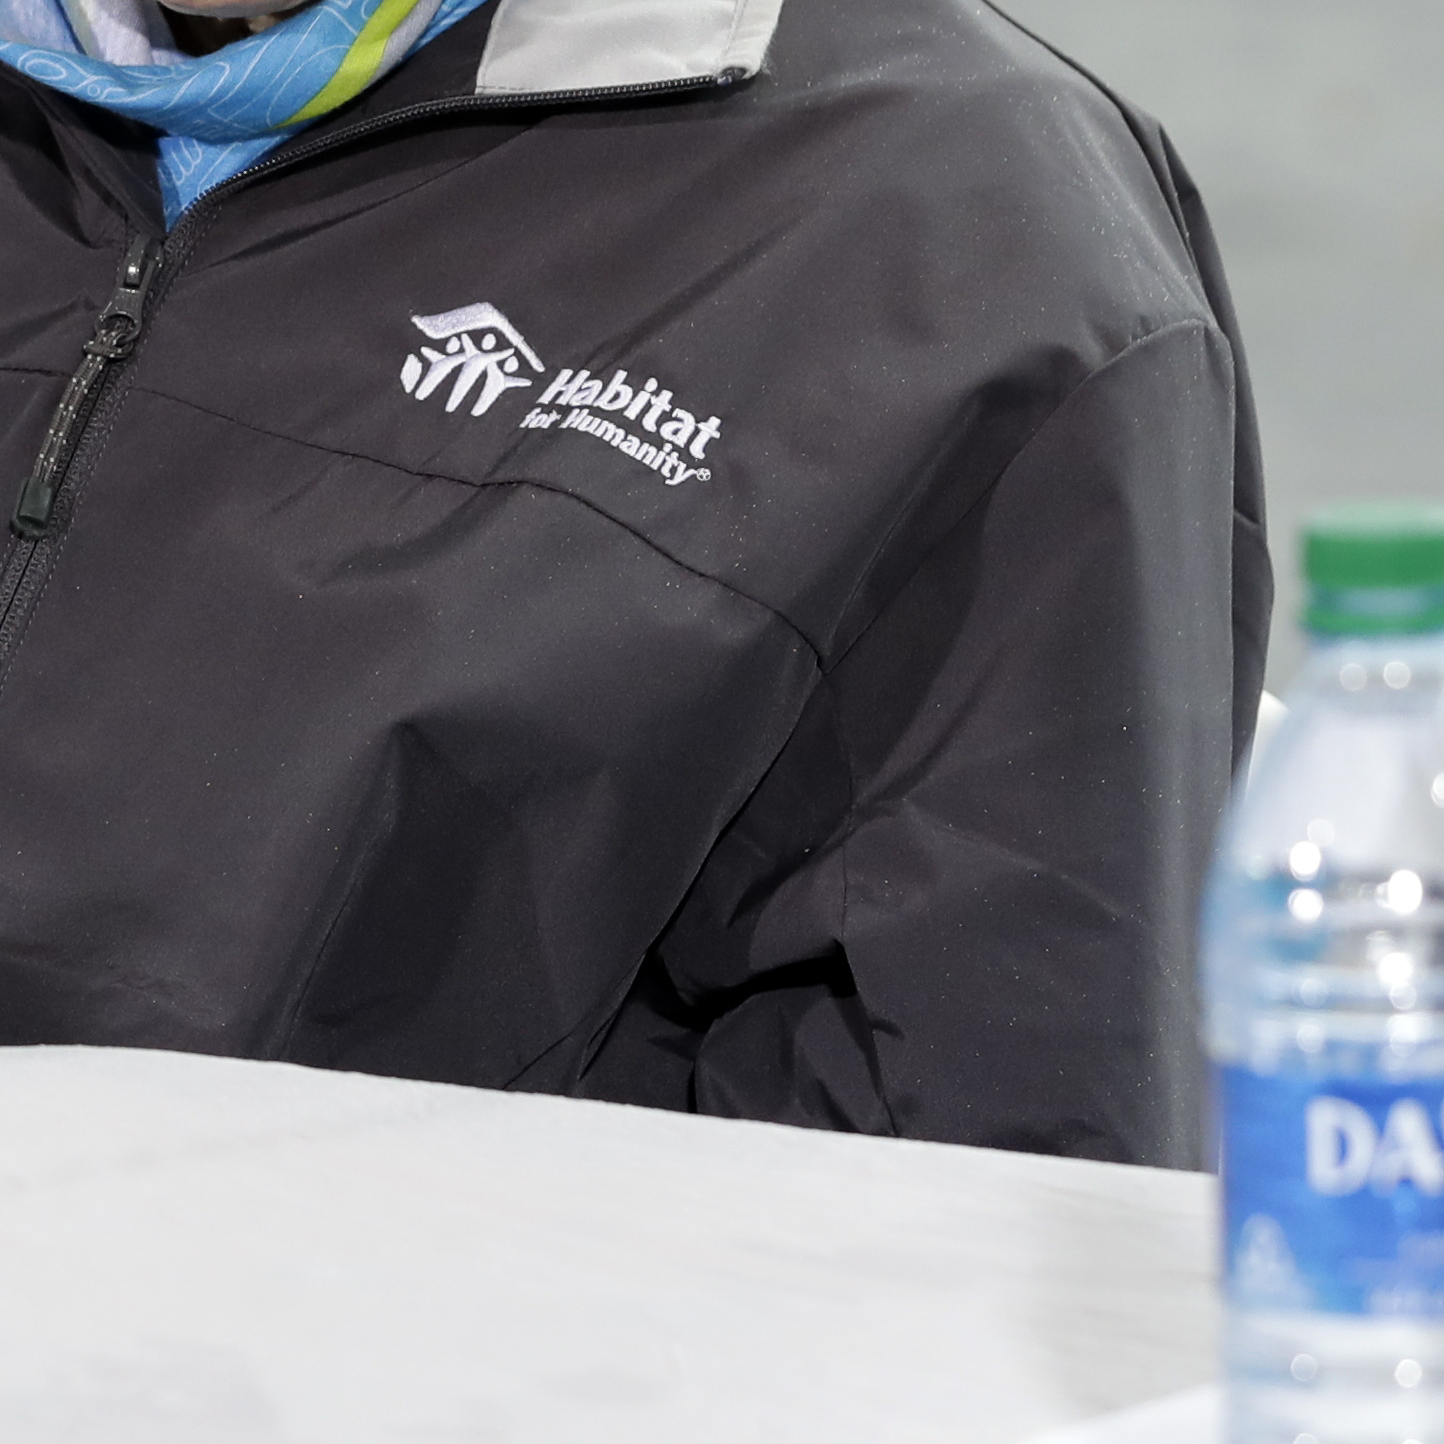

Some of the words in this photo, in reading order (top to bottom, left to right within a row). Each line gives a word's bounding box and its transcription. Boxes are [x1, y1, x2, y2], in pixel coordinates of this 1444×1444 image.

[519, 407, 562, 430] for
[535, 367, 722, 460] Habitat
[1304, 1093, 1444, 1198] DA
